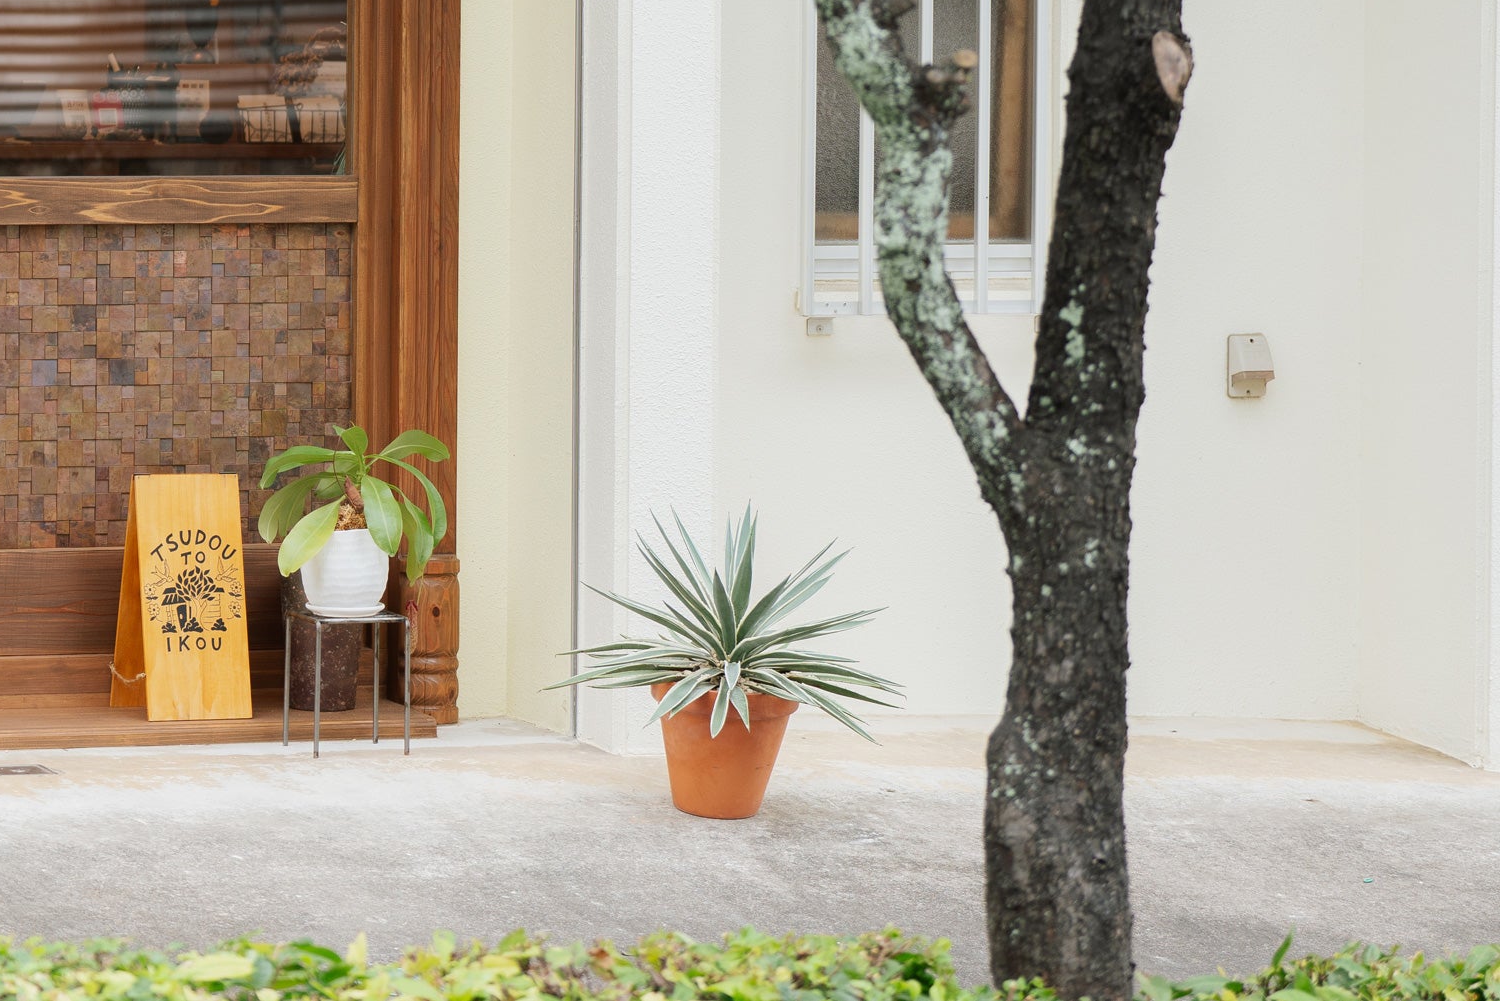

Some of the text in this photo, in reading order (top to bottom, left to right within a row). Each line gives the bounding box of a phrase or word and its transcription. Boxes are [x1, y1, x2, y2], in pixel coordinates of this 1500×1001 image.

[150, 529, 237, 562] TSUDOU
[180, 551, 206, 566] TO
[166, 635, 223, 652] IKOU
